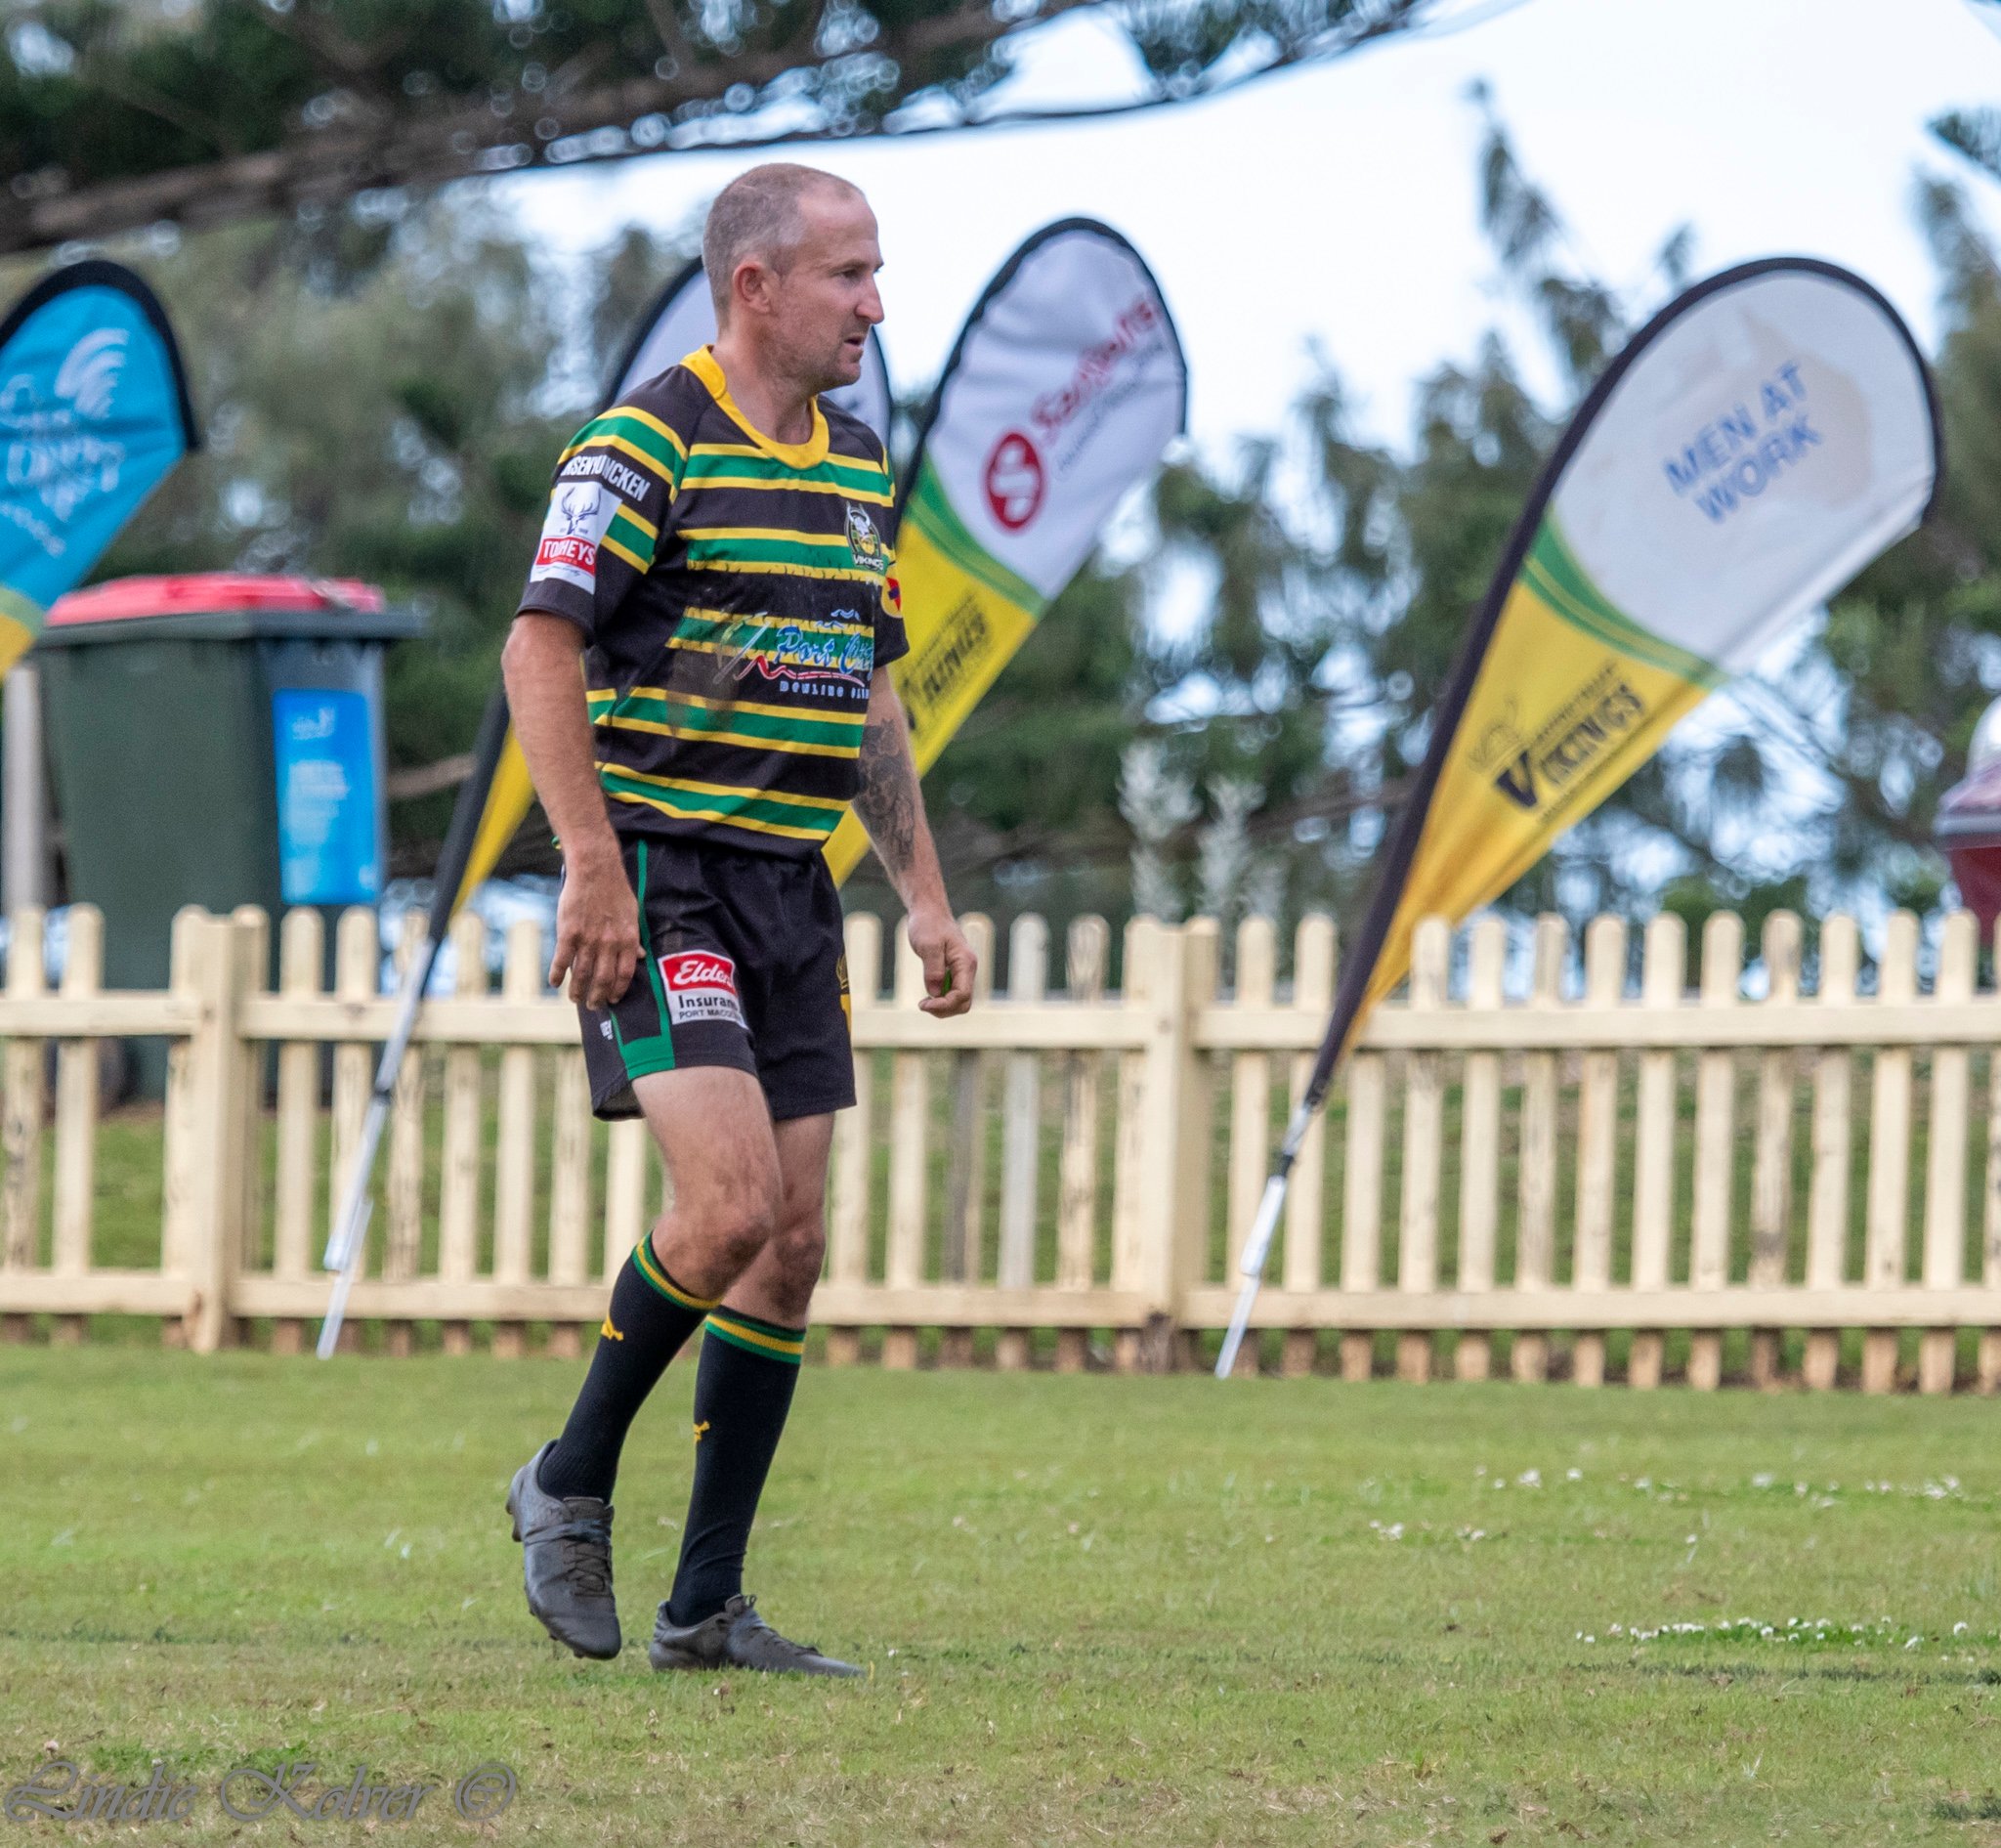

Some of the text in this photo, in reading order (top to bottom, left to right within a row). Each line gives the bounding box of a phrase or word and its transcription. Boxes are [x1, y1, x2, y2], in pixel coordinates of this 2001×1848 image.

[1665, 361, 1806, 494] MEN AT
[1695, 416, 1821, 524] WORK
